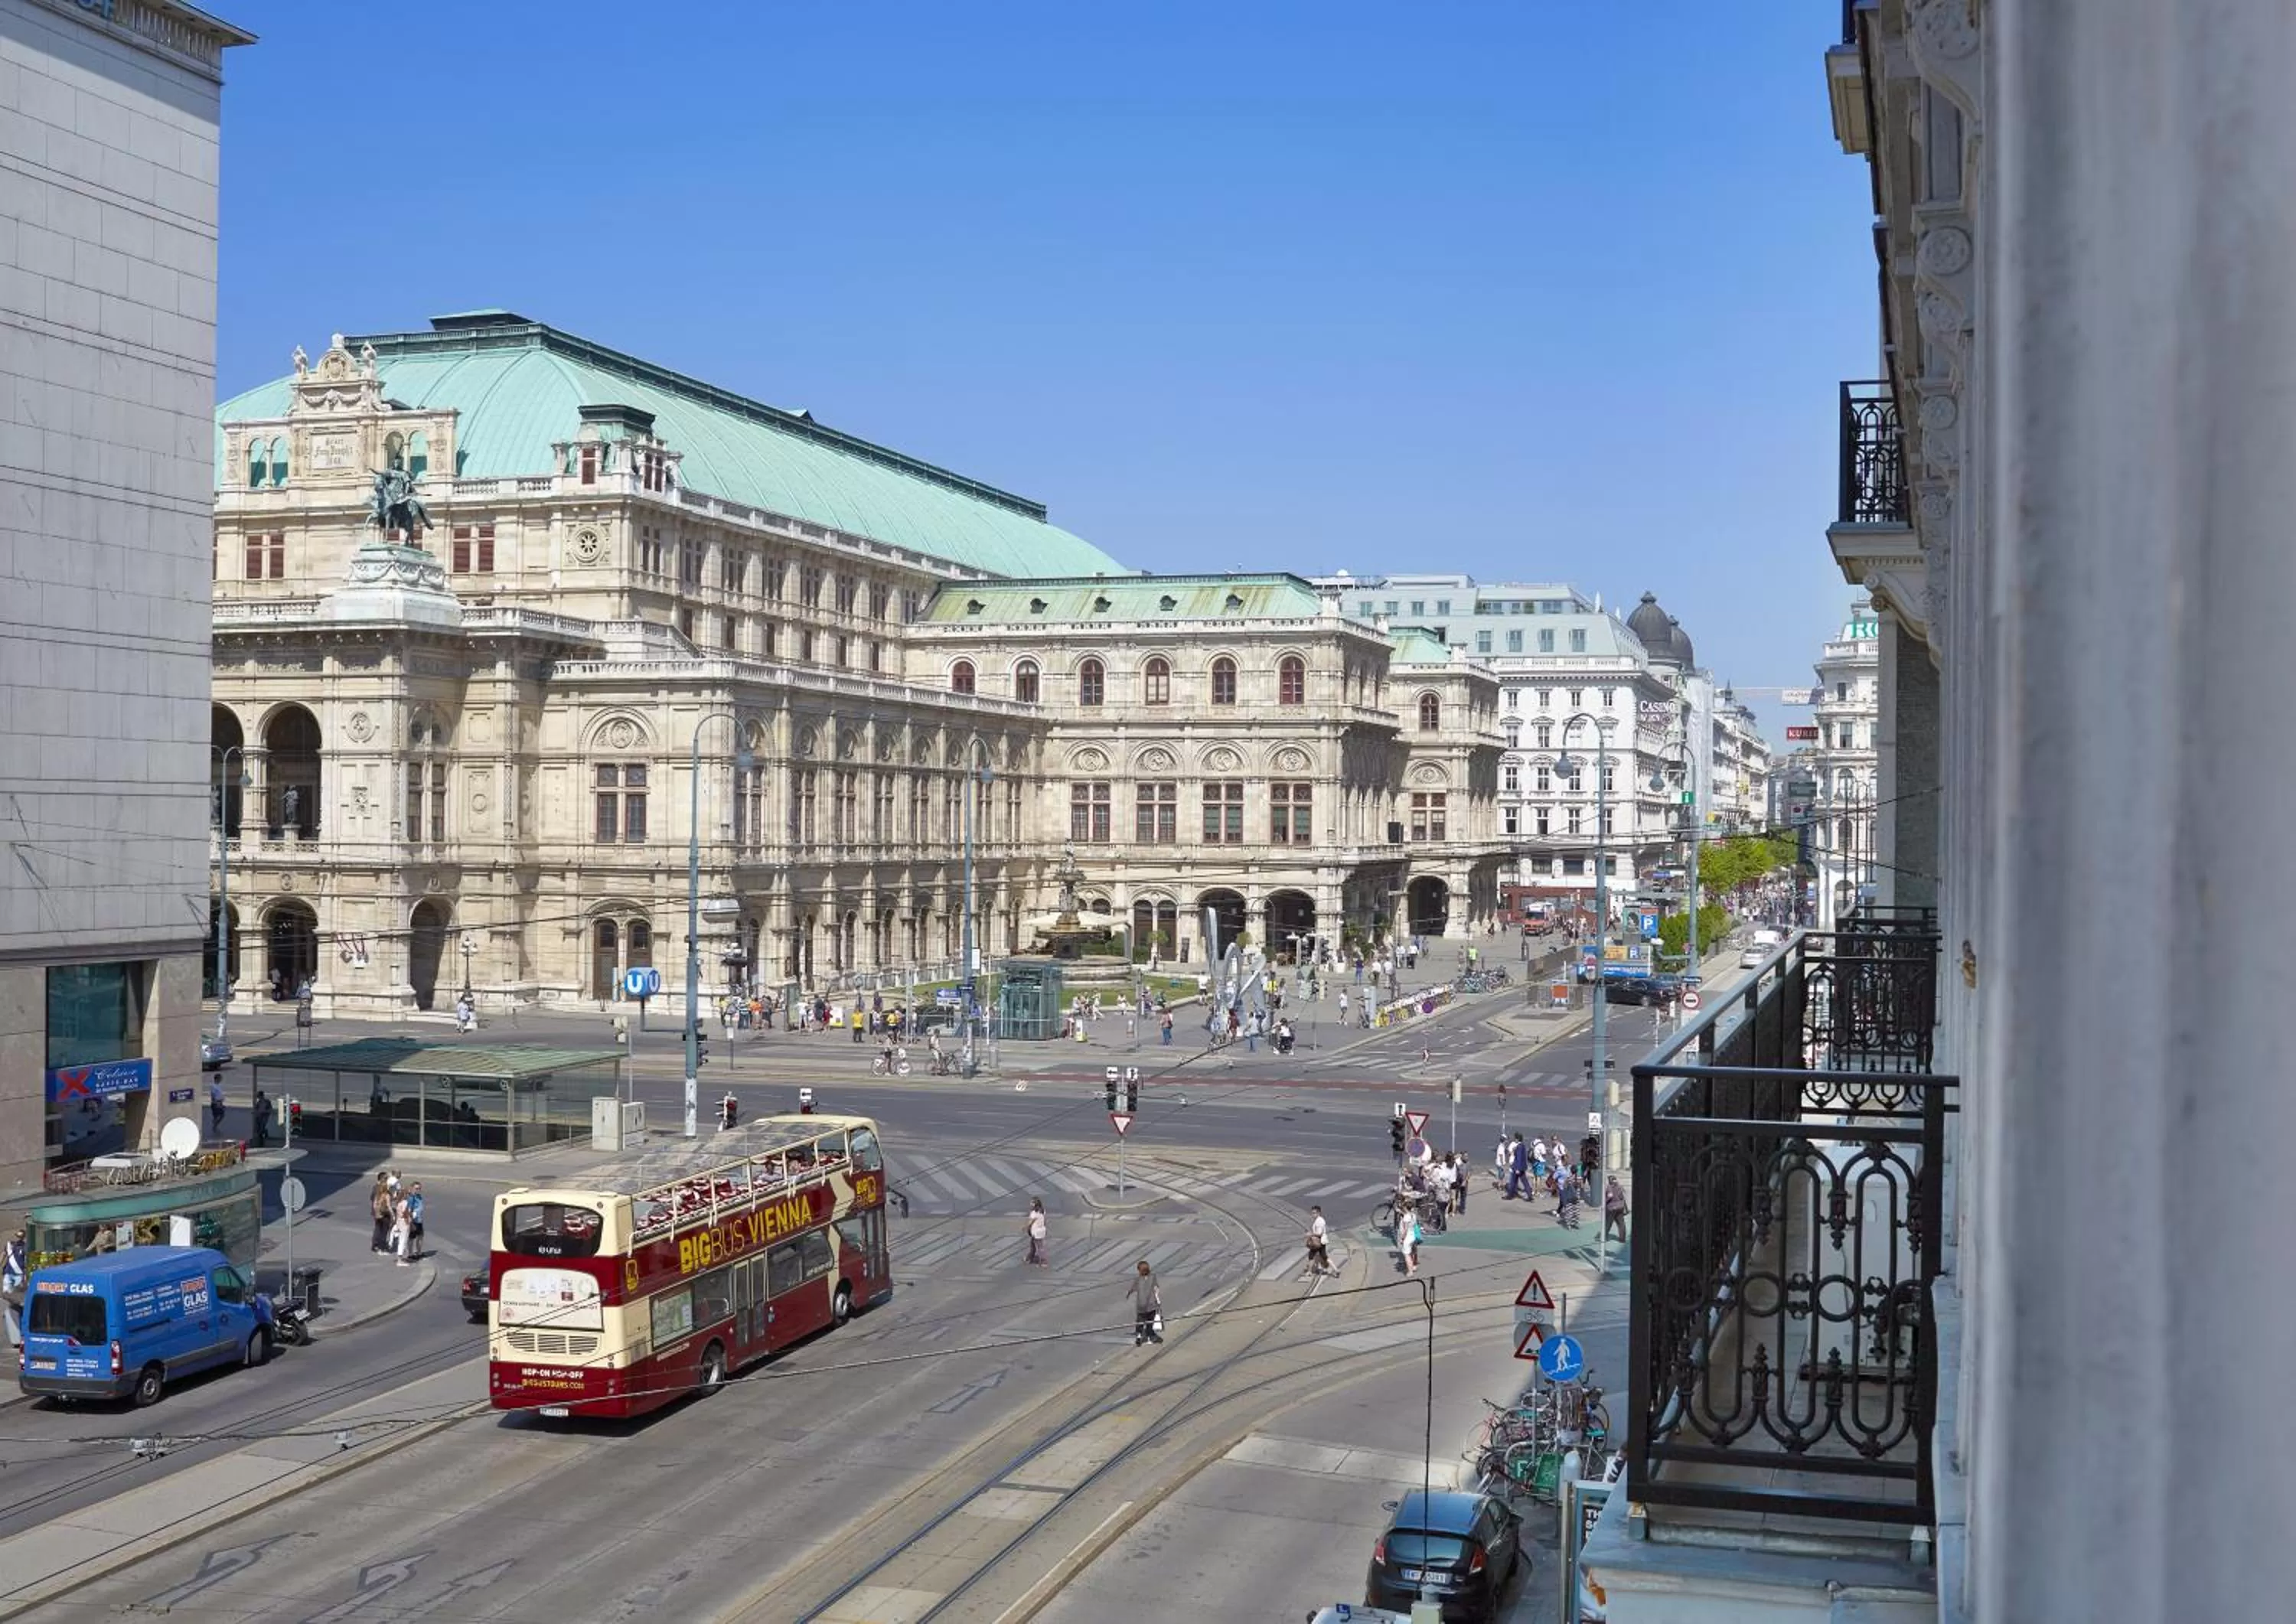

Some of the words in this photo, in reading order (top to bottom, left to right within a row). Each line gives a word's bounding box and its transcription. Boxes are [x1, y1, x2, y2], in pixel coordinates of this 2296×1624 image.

[627, 974, 643, 993] U
[649, 974, 659, 993] U
[748, 1194, 813, 1244] VIENNA
[70, 1283, 94, 1293] GLAS
[184, 1291, 208, 1308] GLAS
